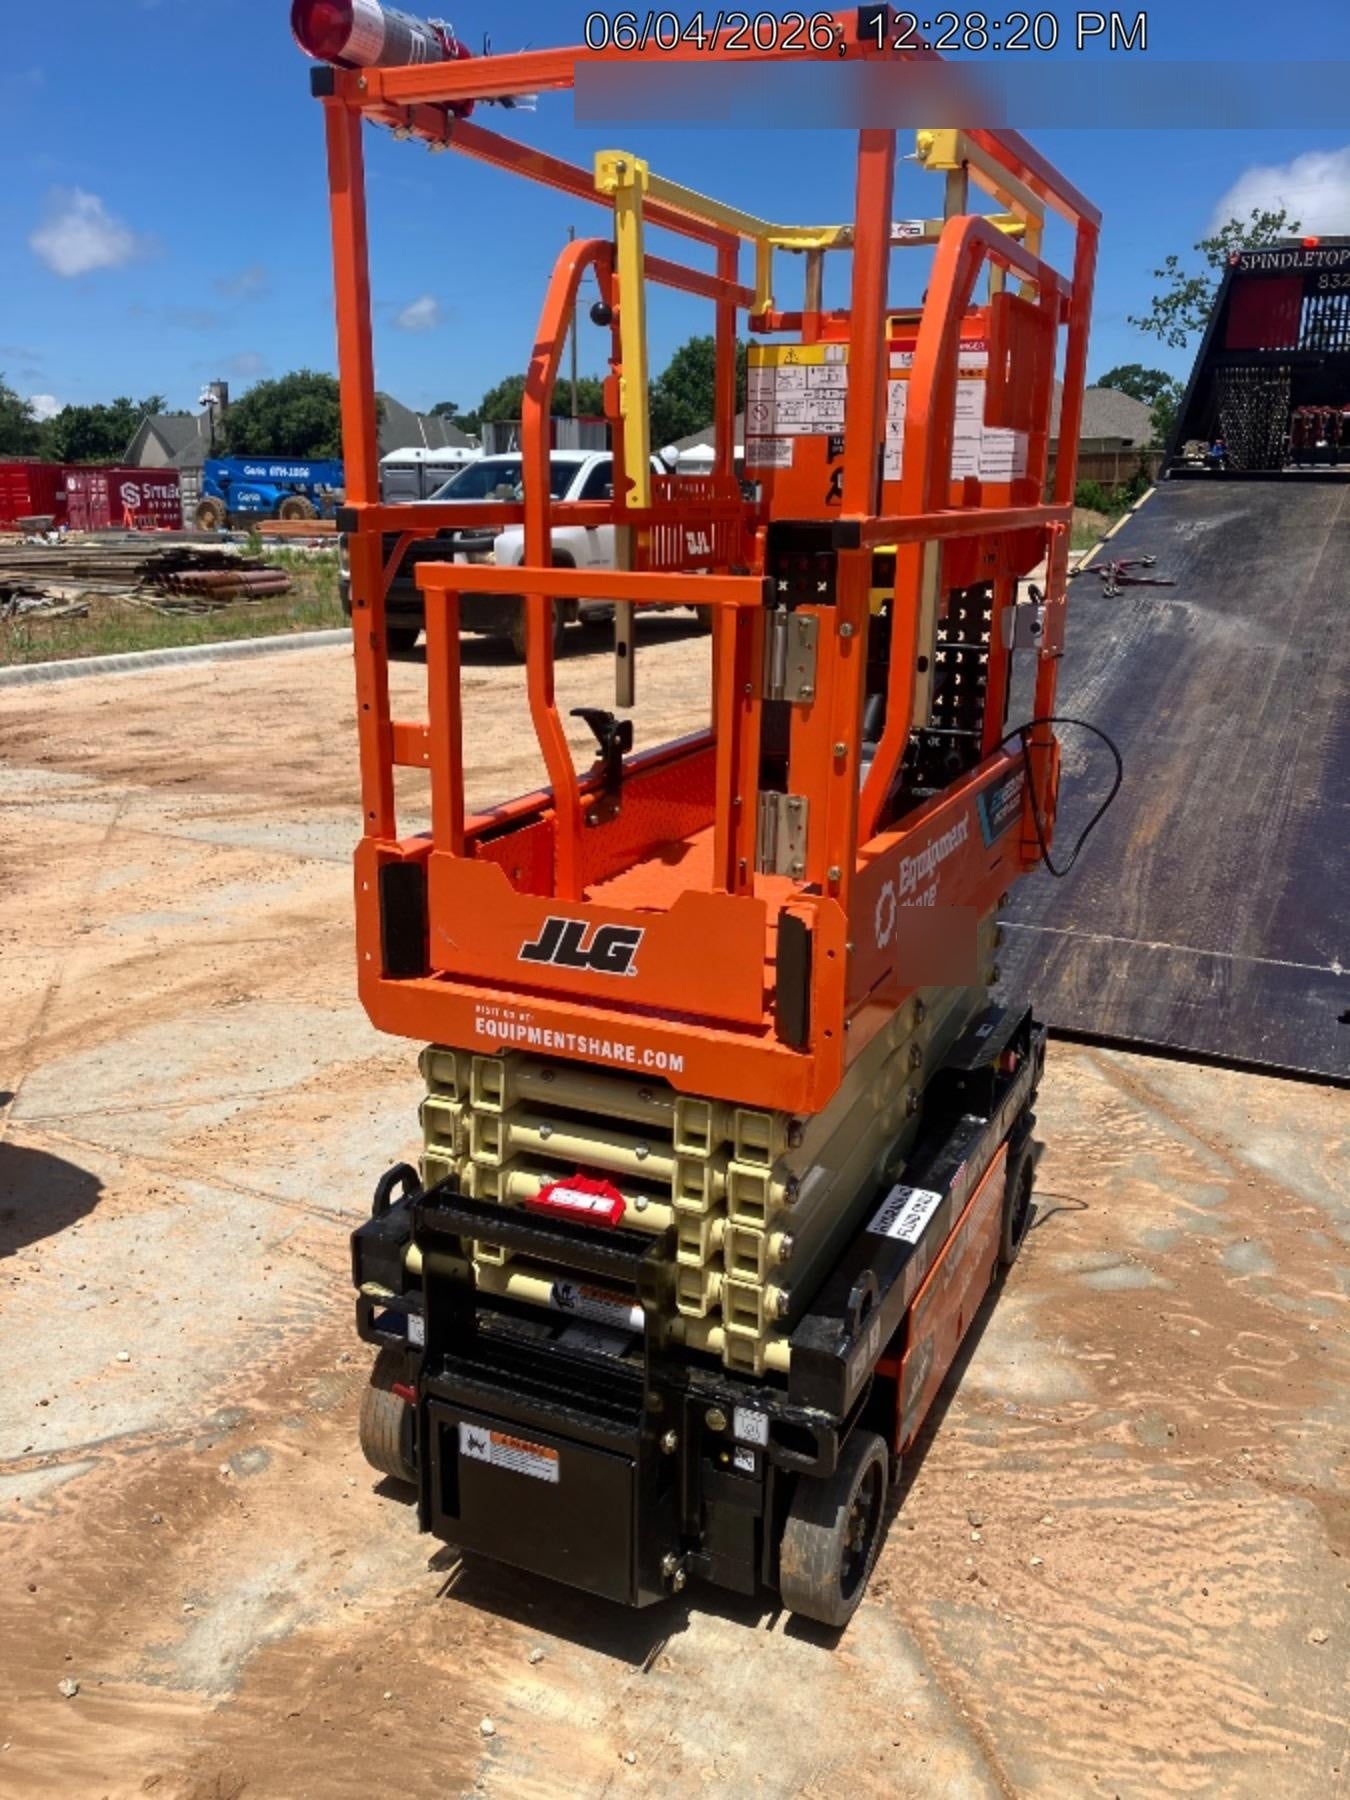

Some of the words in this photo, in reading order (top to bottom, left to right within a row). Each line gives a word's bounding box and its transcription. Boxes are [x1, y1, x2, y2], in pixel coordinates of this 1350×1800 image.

[1240, 248, 1350, 271] SPINDLETOP
[899, 809, 969, 897] Equipment
[517, 915, 646, 976] JLG
[475, 1017, 684, 1072] EQUIPMENTSHARE.COM
